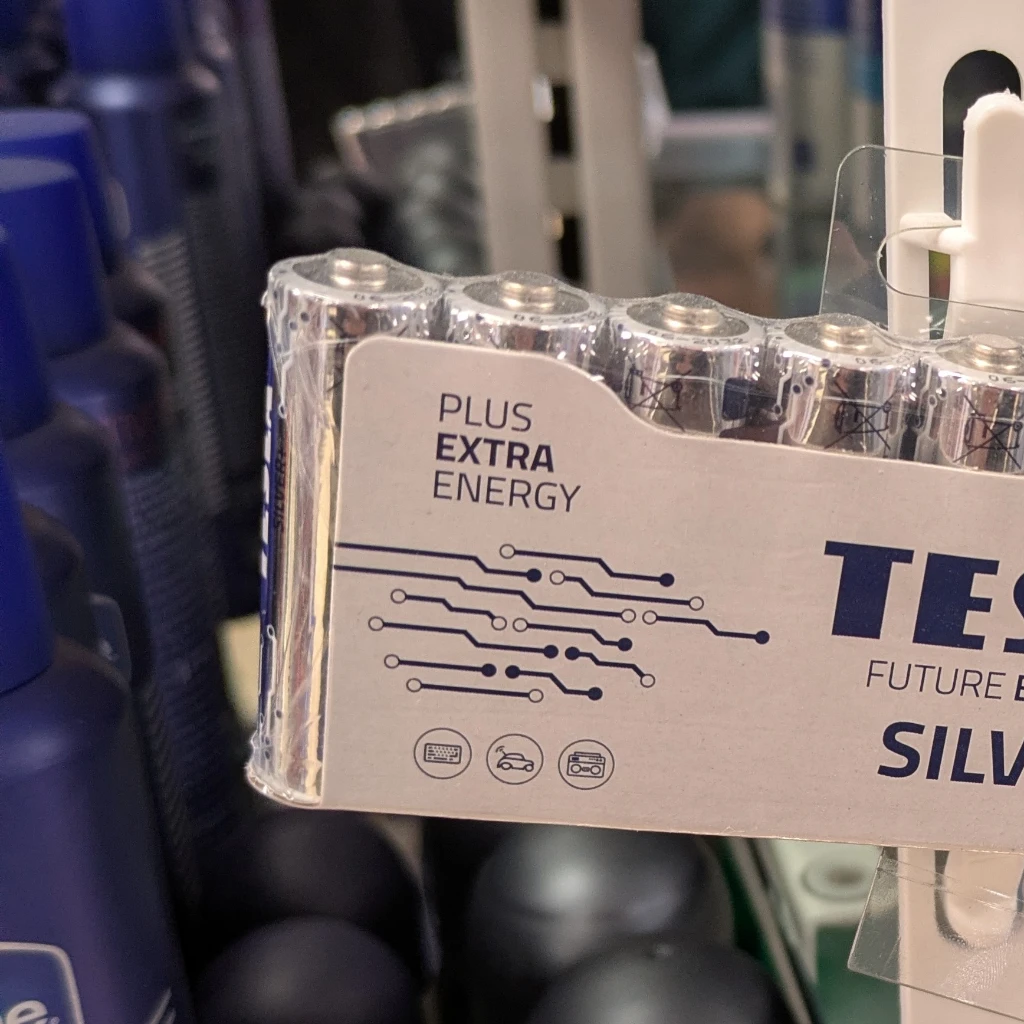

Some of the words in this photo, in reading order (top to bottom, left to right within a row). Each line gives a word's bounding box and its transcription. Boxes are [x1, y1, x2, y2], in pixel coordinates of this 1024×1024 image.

[439, 392, 533, 432] PLUS
[435, 432, 555, 473] EXTRA
[433, 471, 581, 513] ENERGY
[865, 659, 1006, 700] FUTURE
